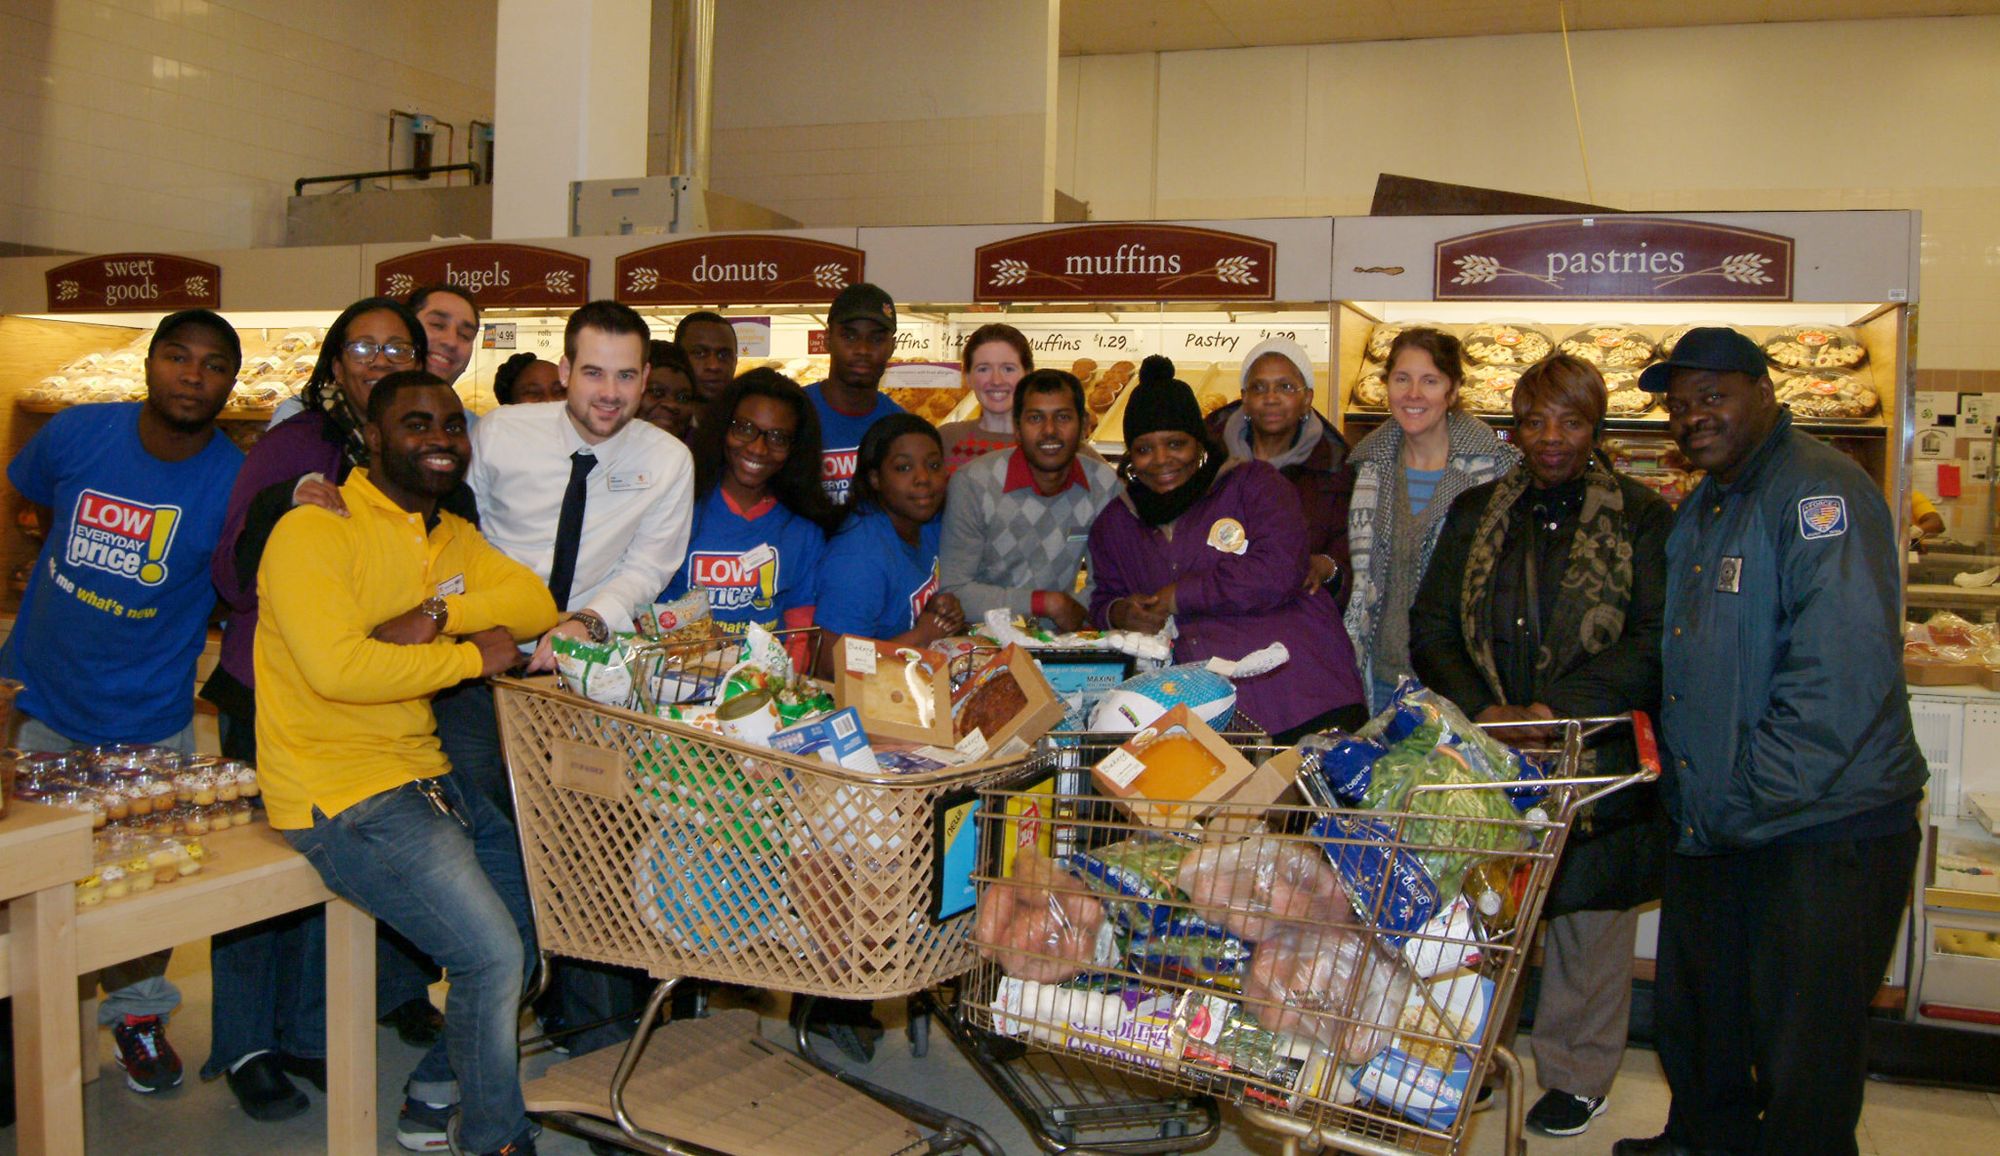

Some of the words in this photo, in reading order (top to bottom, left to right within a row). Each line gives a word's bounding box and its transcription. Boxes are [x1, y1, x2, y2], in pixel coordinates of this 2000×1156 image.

[104, 258, 156, 277] sweet
[692, 254, 778, 282] donuts
[1065, 243, 1181, 274] muffins
[1545, 241, 1685, 282] pastries
[446, 261, 511, 293] bagels
[105, 276, 159, 306] goods
[895, 332, 930, 350] ffins
[1093, 333, 1127, 350] $1.29
[1185, 331, 1240, 353] Pastry
[822, 455, 858, 477] OW
[822, 479, 850, 490] ERYD
[82, 498, 152, 535] LOW
[76, 525, 145, 552] EVERYDAY
[696, 559, 754, 583] LOW
[55, 573, 75, 594] me
[76, 587, 124, 617] what's
[1346, 765, 1370, 790] beans
[1401, 875, 1430, 906] green
